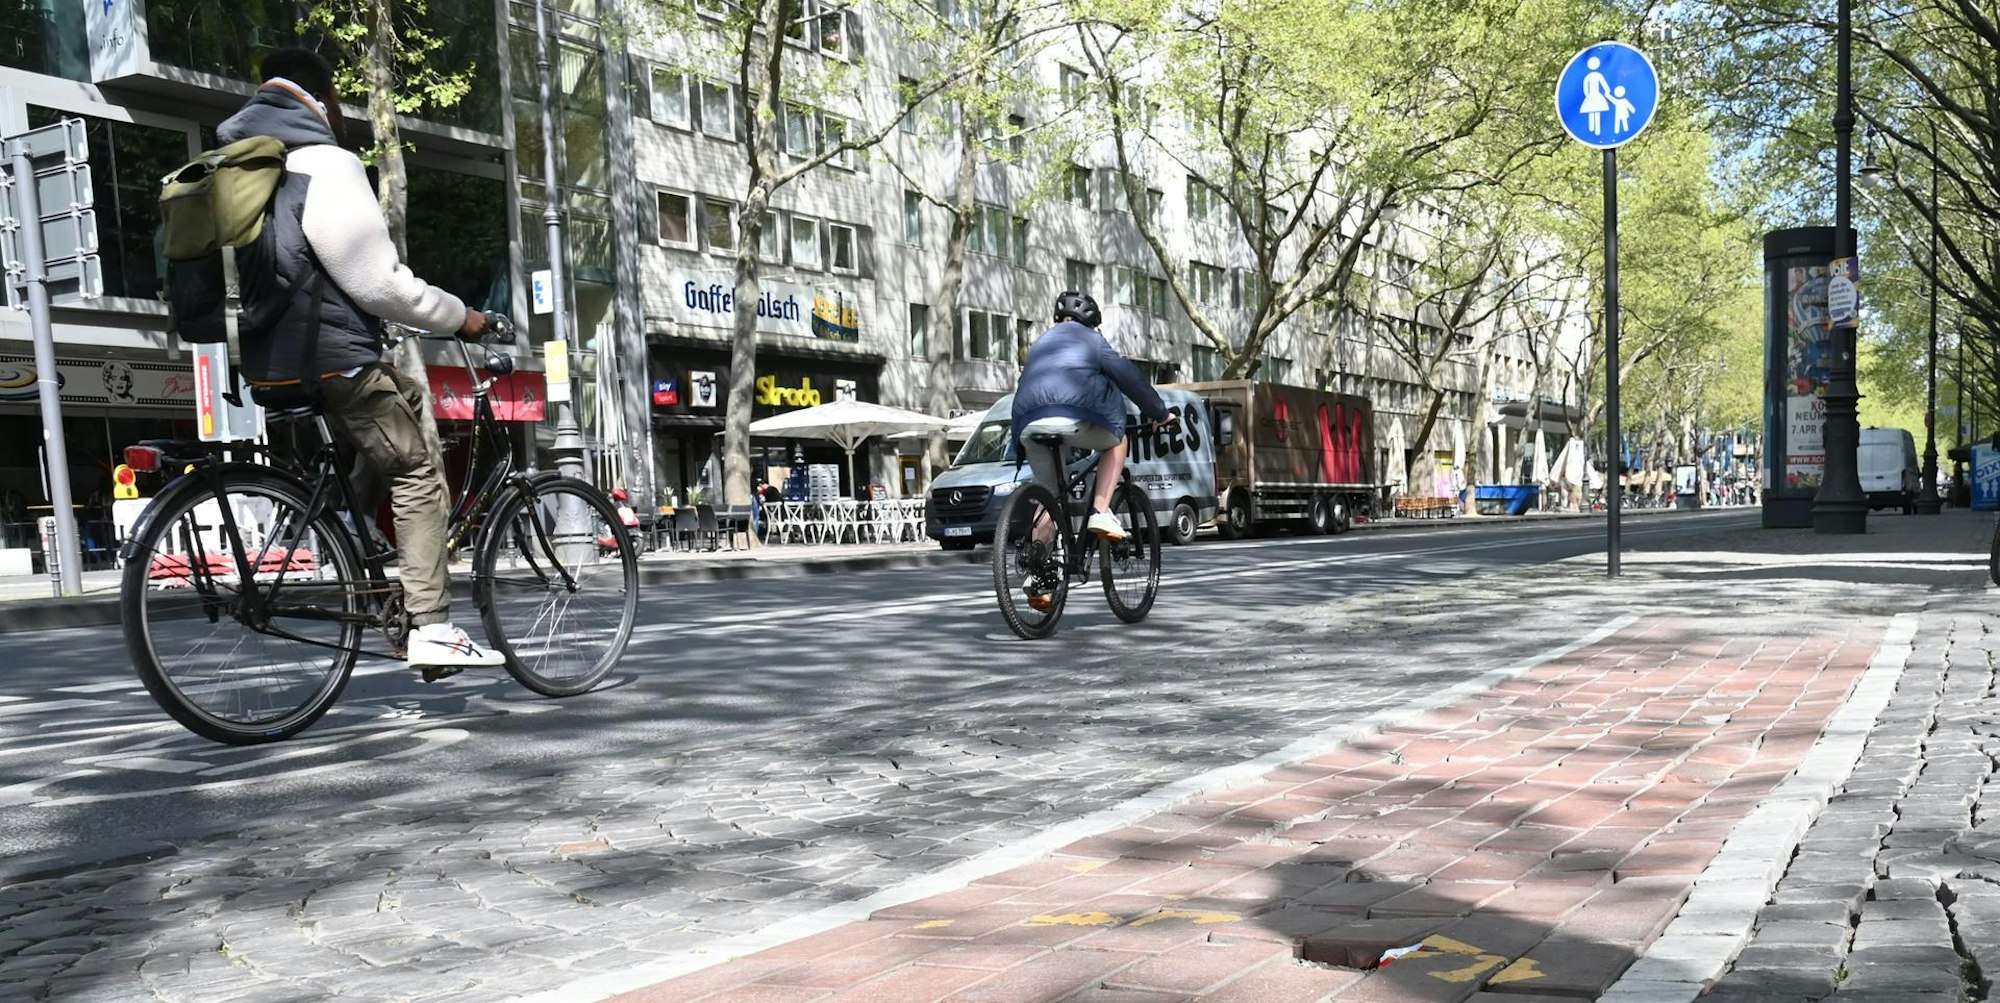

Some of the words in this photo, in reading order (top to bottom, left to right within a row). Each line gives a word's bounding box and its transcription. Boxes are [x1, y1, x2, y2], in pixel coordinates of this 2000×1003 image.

[757, 291, 799, 323] ölsch
[658, 382, 672, 392] sky
[756, 375, 821, 407] Strada
[1795, 411, 1827, 422] NEUM
